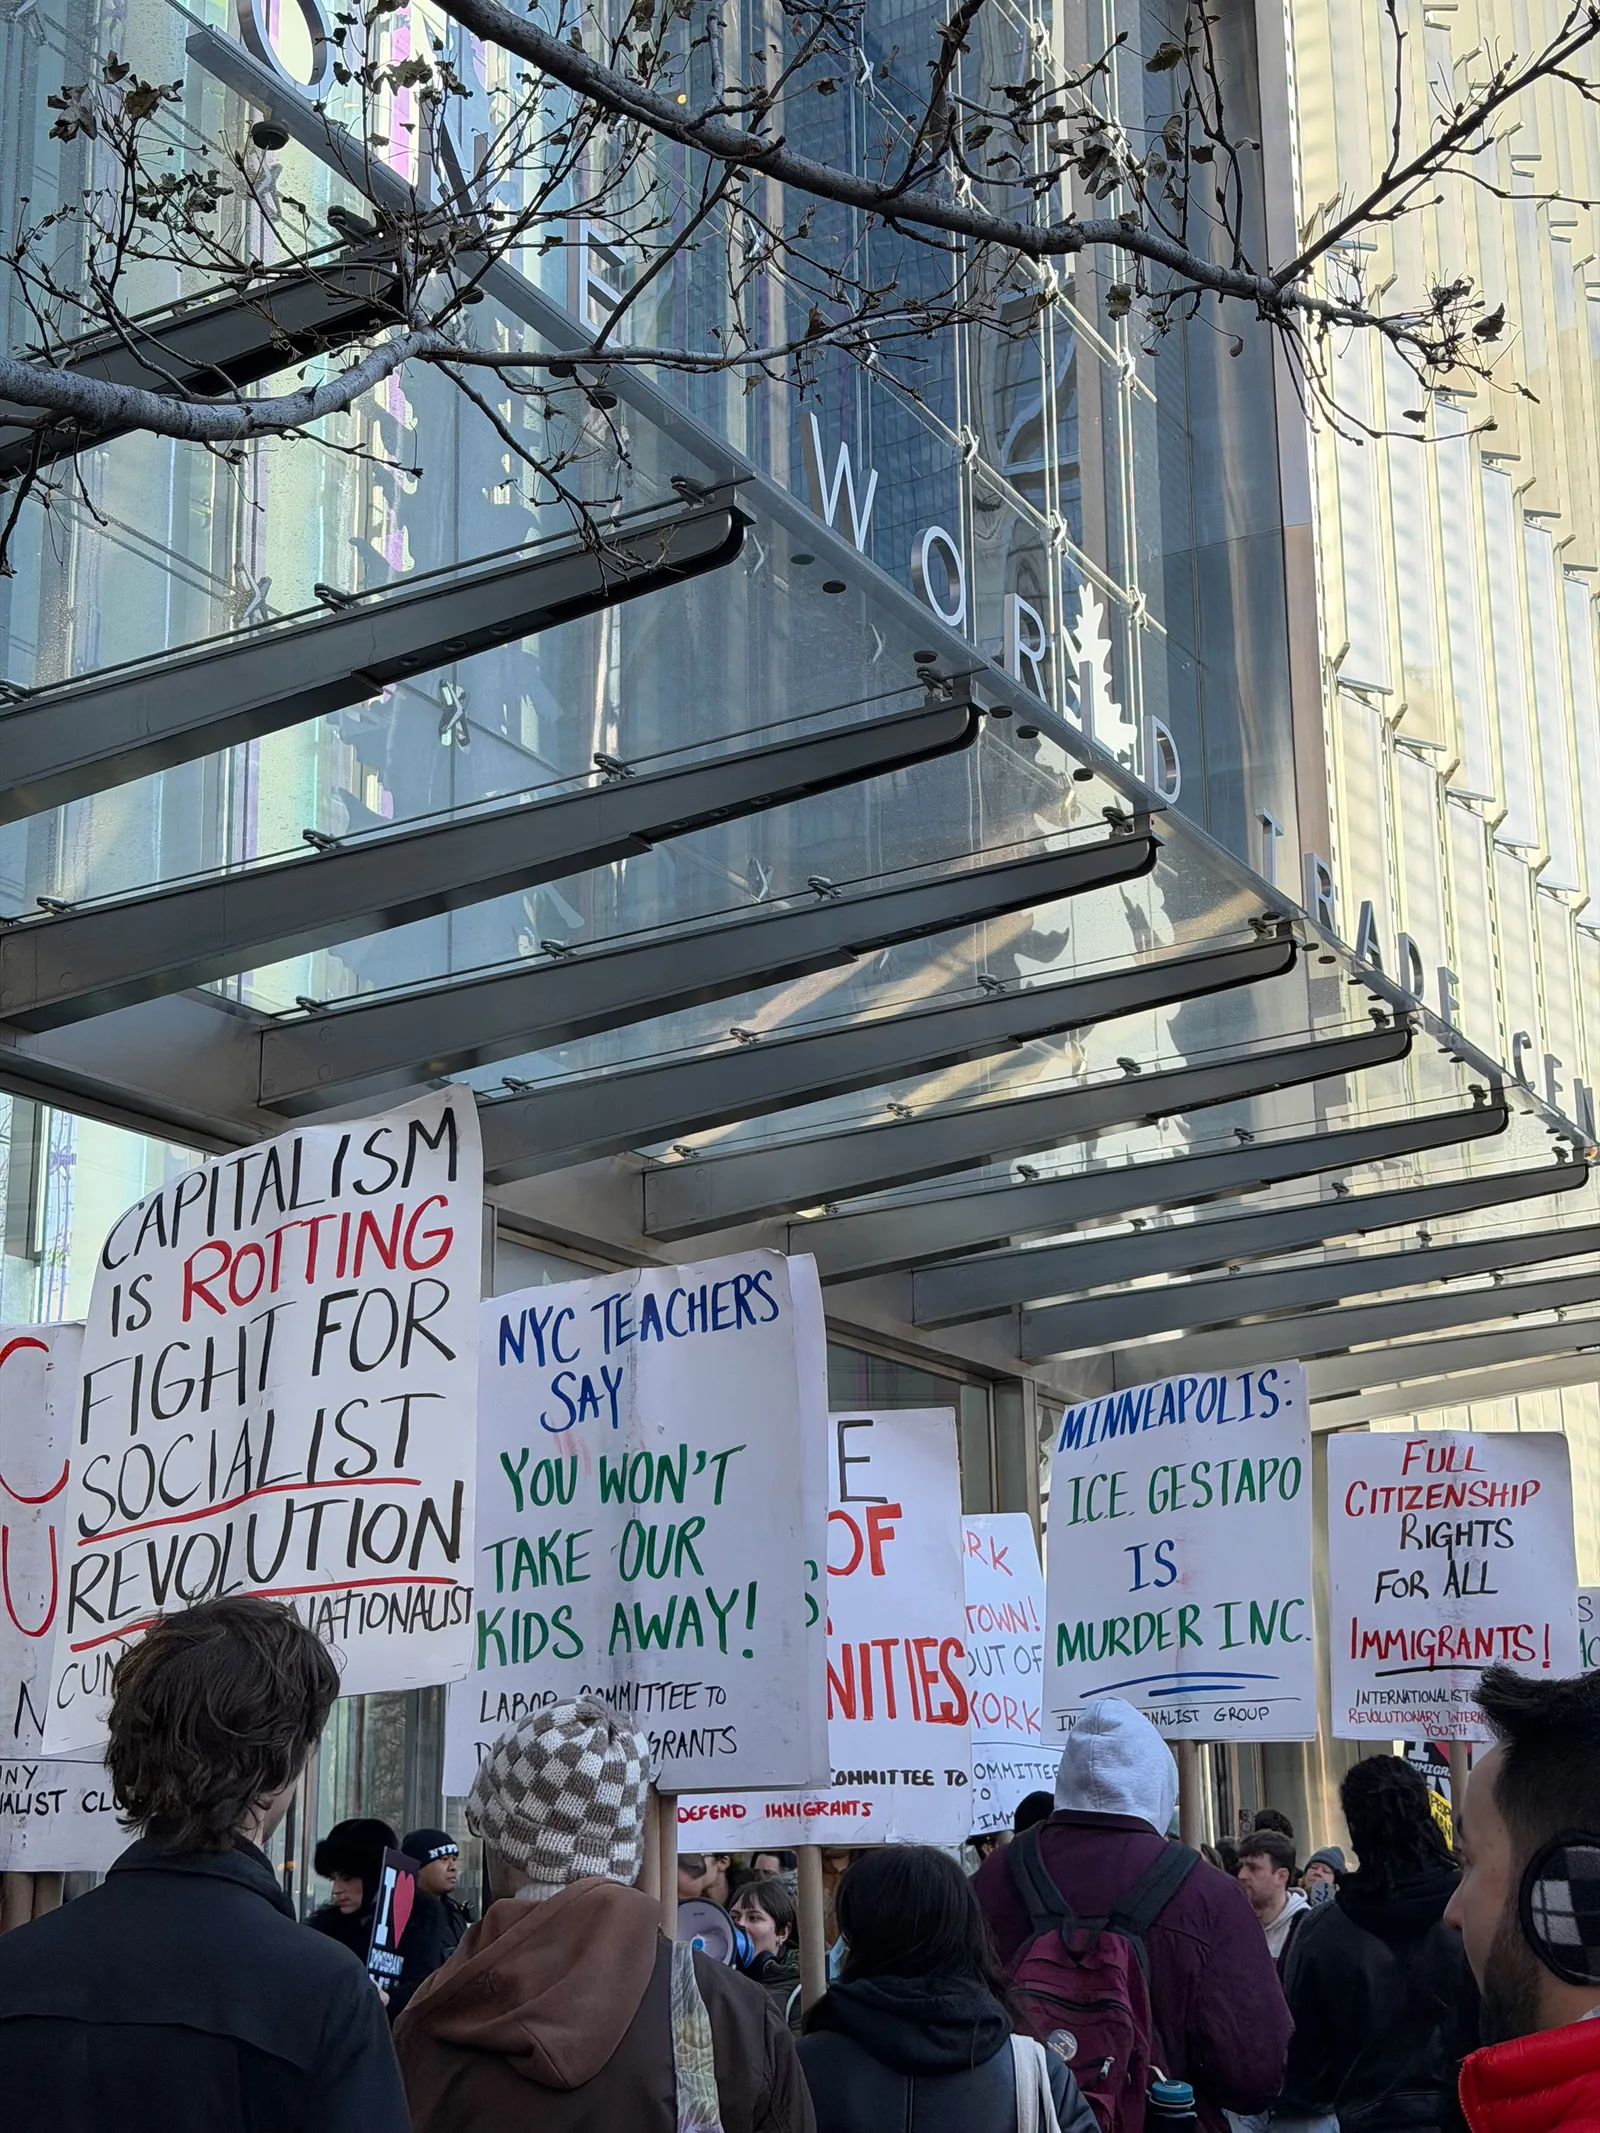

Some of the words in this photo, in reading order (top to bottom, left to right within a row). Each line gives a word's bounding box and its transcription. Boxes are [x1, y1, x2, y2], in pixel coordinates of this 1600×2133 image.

[802, 411, 1181, 804] WORLD
[1255, 807, 1460, 1035] TRADE
[102, 1107, 457, 1270] CAPITALISM
[111, 1273, 152, 1338] IS
[182, 1194, 454, 1322] ROTTING
[499, 1304, 581, 1367] NYC
[590, 1269, 779, 1355] TEACHERS
[80, 1300, 297, 1446] FIGHT
[311, 1277, 457, 1377] FOR
[540, 1365, 623, 1433] SAY
[1057, 1368, 1293, 1453] MINNEAPOLIS:
[78, 1392, 446, 1537] SOCIALIST
[500, 1446, 578, 1513] YOU
[599, 1443, 748, 1506] WON'T
[1148, 1456, 1302, 1515] GESTAPO
[1401, 1439, 1487, 1476] FULL
[1345, 1479, 1541, 1517] CITIZENSHIP
[67, 1480, 464, 1635] REVOLUTION
[482, 1528, 594, 1594] TAKE
[612, 1515, 706, 1582] OUR
[1124, 1539, 1179, 1593] IS
[1400, 1512, 1515, 1561] RIGHTS
[1374, 1568, 1430, 1604] FOR
[1442, 1559, 1499, 1599] ALL
[476, 1603, 585, 1672] KIDS
[608, 1581, 758, 1660] AWAY!
[1056, 1603, 1204, 1668] MURDER
[1213, 1598, 1312, 1651] INC.
[1351, 1616, 1551, 1669] IMMIGRANTS!
[1013, 1643, 1042, 1676] OF
[704, 1685, 727, 1708] TO
[1213, 1706, 1270, 1723] GROUP
[1348, 1707, 1440, 1725] REVOLUTIONARY
[1422, 1721, 1468, 1739] YOUTH
[944, 1769, 969, 1787] TO
[676, 1803, 747, 1824] DEFEND
